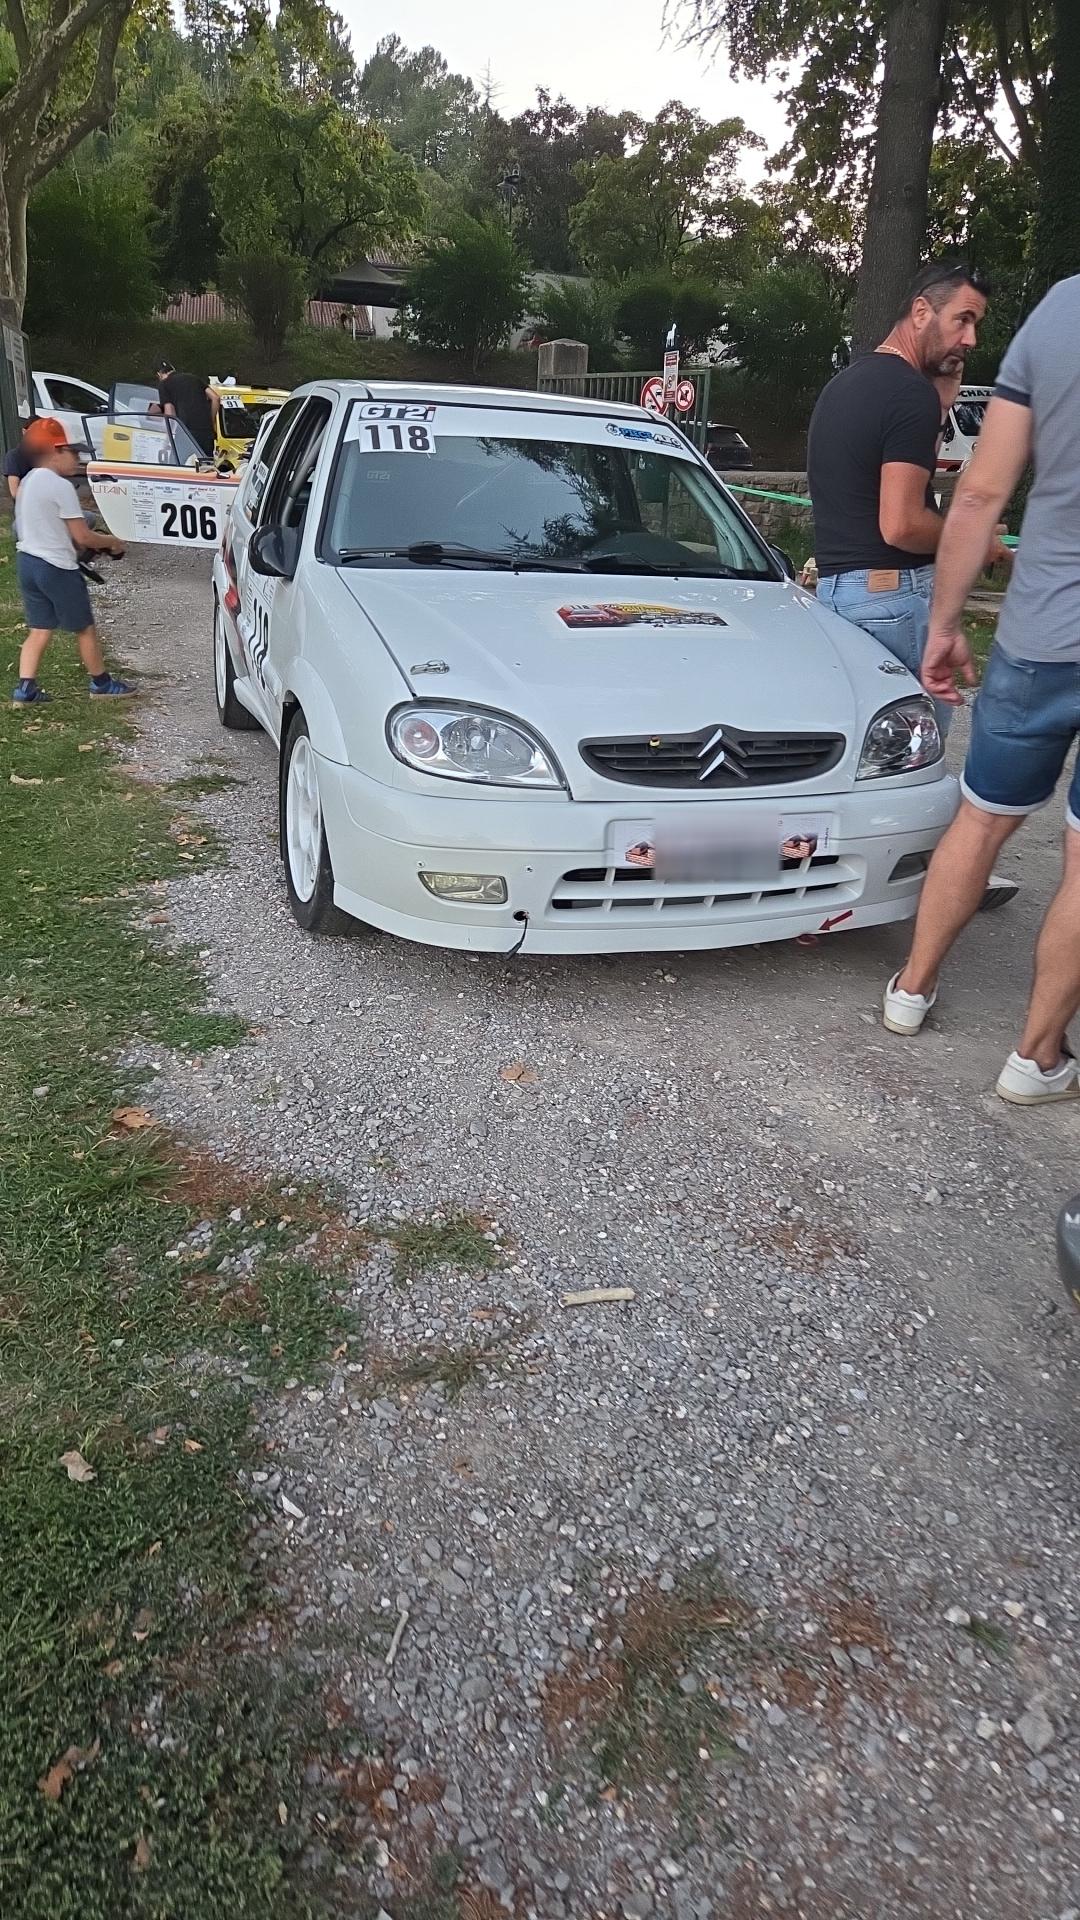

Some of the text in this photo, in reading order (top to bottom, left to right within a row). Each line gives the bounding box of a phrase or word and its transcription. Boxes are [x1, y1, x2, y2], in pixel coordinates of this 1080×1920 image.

[226, 400, 239, 408] 91
[364, 424, 430, 451] 118
[161, 502, 217, 541] 206
